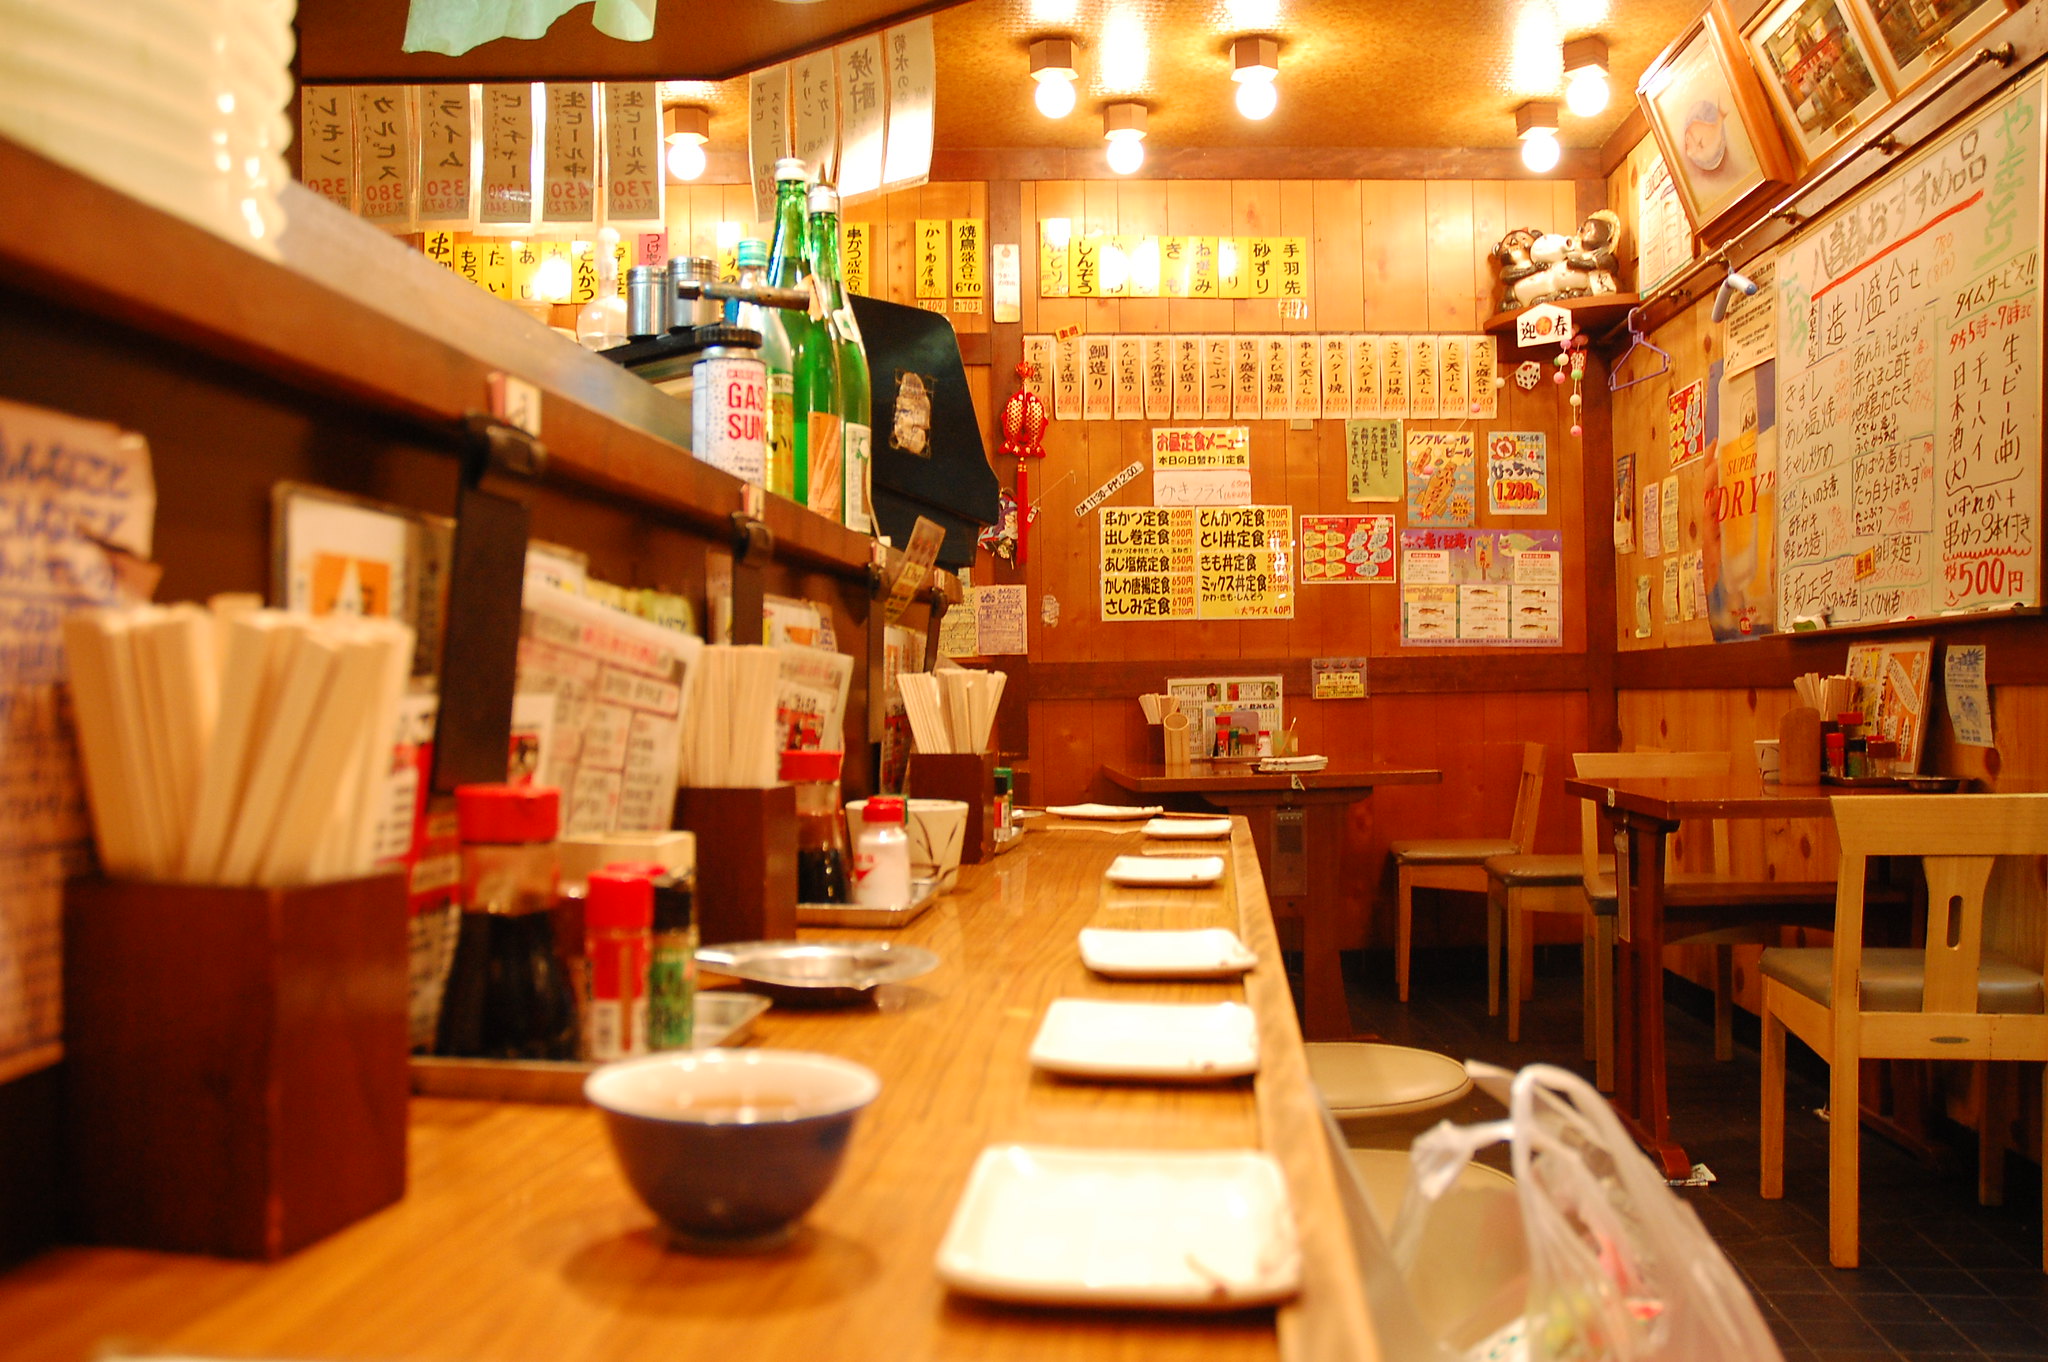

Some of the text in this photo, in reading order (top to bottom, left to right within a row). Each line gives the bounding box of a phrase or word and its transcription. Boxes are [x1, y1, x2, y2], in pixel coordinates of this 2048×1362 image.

[488, 250, 505, 292] たい
[519, 250, 535, 300] あじ
[578, 250, 595, 301] とんかつ
[1077, 241, 1094, 295] しんぞう
[1253, 243, 1272, 295] 砂ずり
[1283, 243, 1301, 295] 手羽先
[955, 282, 981, 293] 670
[1088, 344, 1109, 391] 鯛造り
[1209, 341, 1227, 391] たこぶつ
[1417, 341, 1431, 395] あなご天ぷら
[1445, 341, 1460, 393] たこ天ぷら
[727, 381, 765, 412] GAS
[1971, 351, 1991, 462] チューハイ
[727, 413, 766, 443] SUN
[1158, 455, 1245, 466] 本日の日替わり定食
[1445, 448, 1473, 458] ビール
[1726, 452, 1758, 477] SUPER
[1105, 510, 1170, 526] 串かつ定食
[1171, 510, 1193, 519] 600円
[1200, 508, 1265, 527] とんかつ定食
[1266, 508, 1288, 519] 700円
[1105, 528, 1193, 546] 出し巻定食 600円
[1200, 529, 1265, 549] とり丼定食
[1104, 555, 1194, 573] あじ塩焼定食 650円
[1201, 553, 1257, 572] きも丼定食
[1957, 557, 2024, 598] 500円
[1105, 576, 1194, 595] かしわ唐揚定食 650円
[1201, 573, 1267, 593] ミックス丼定食
[1106, 596, 1194, 616] さしみ定食 670円
